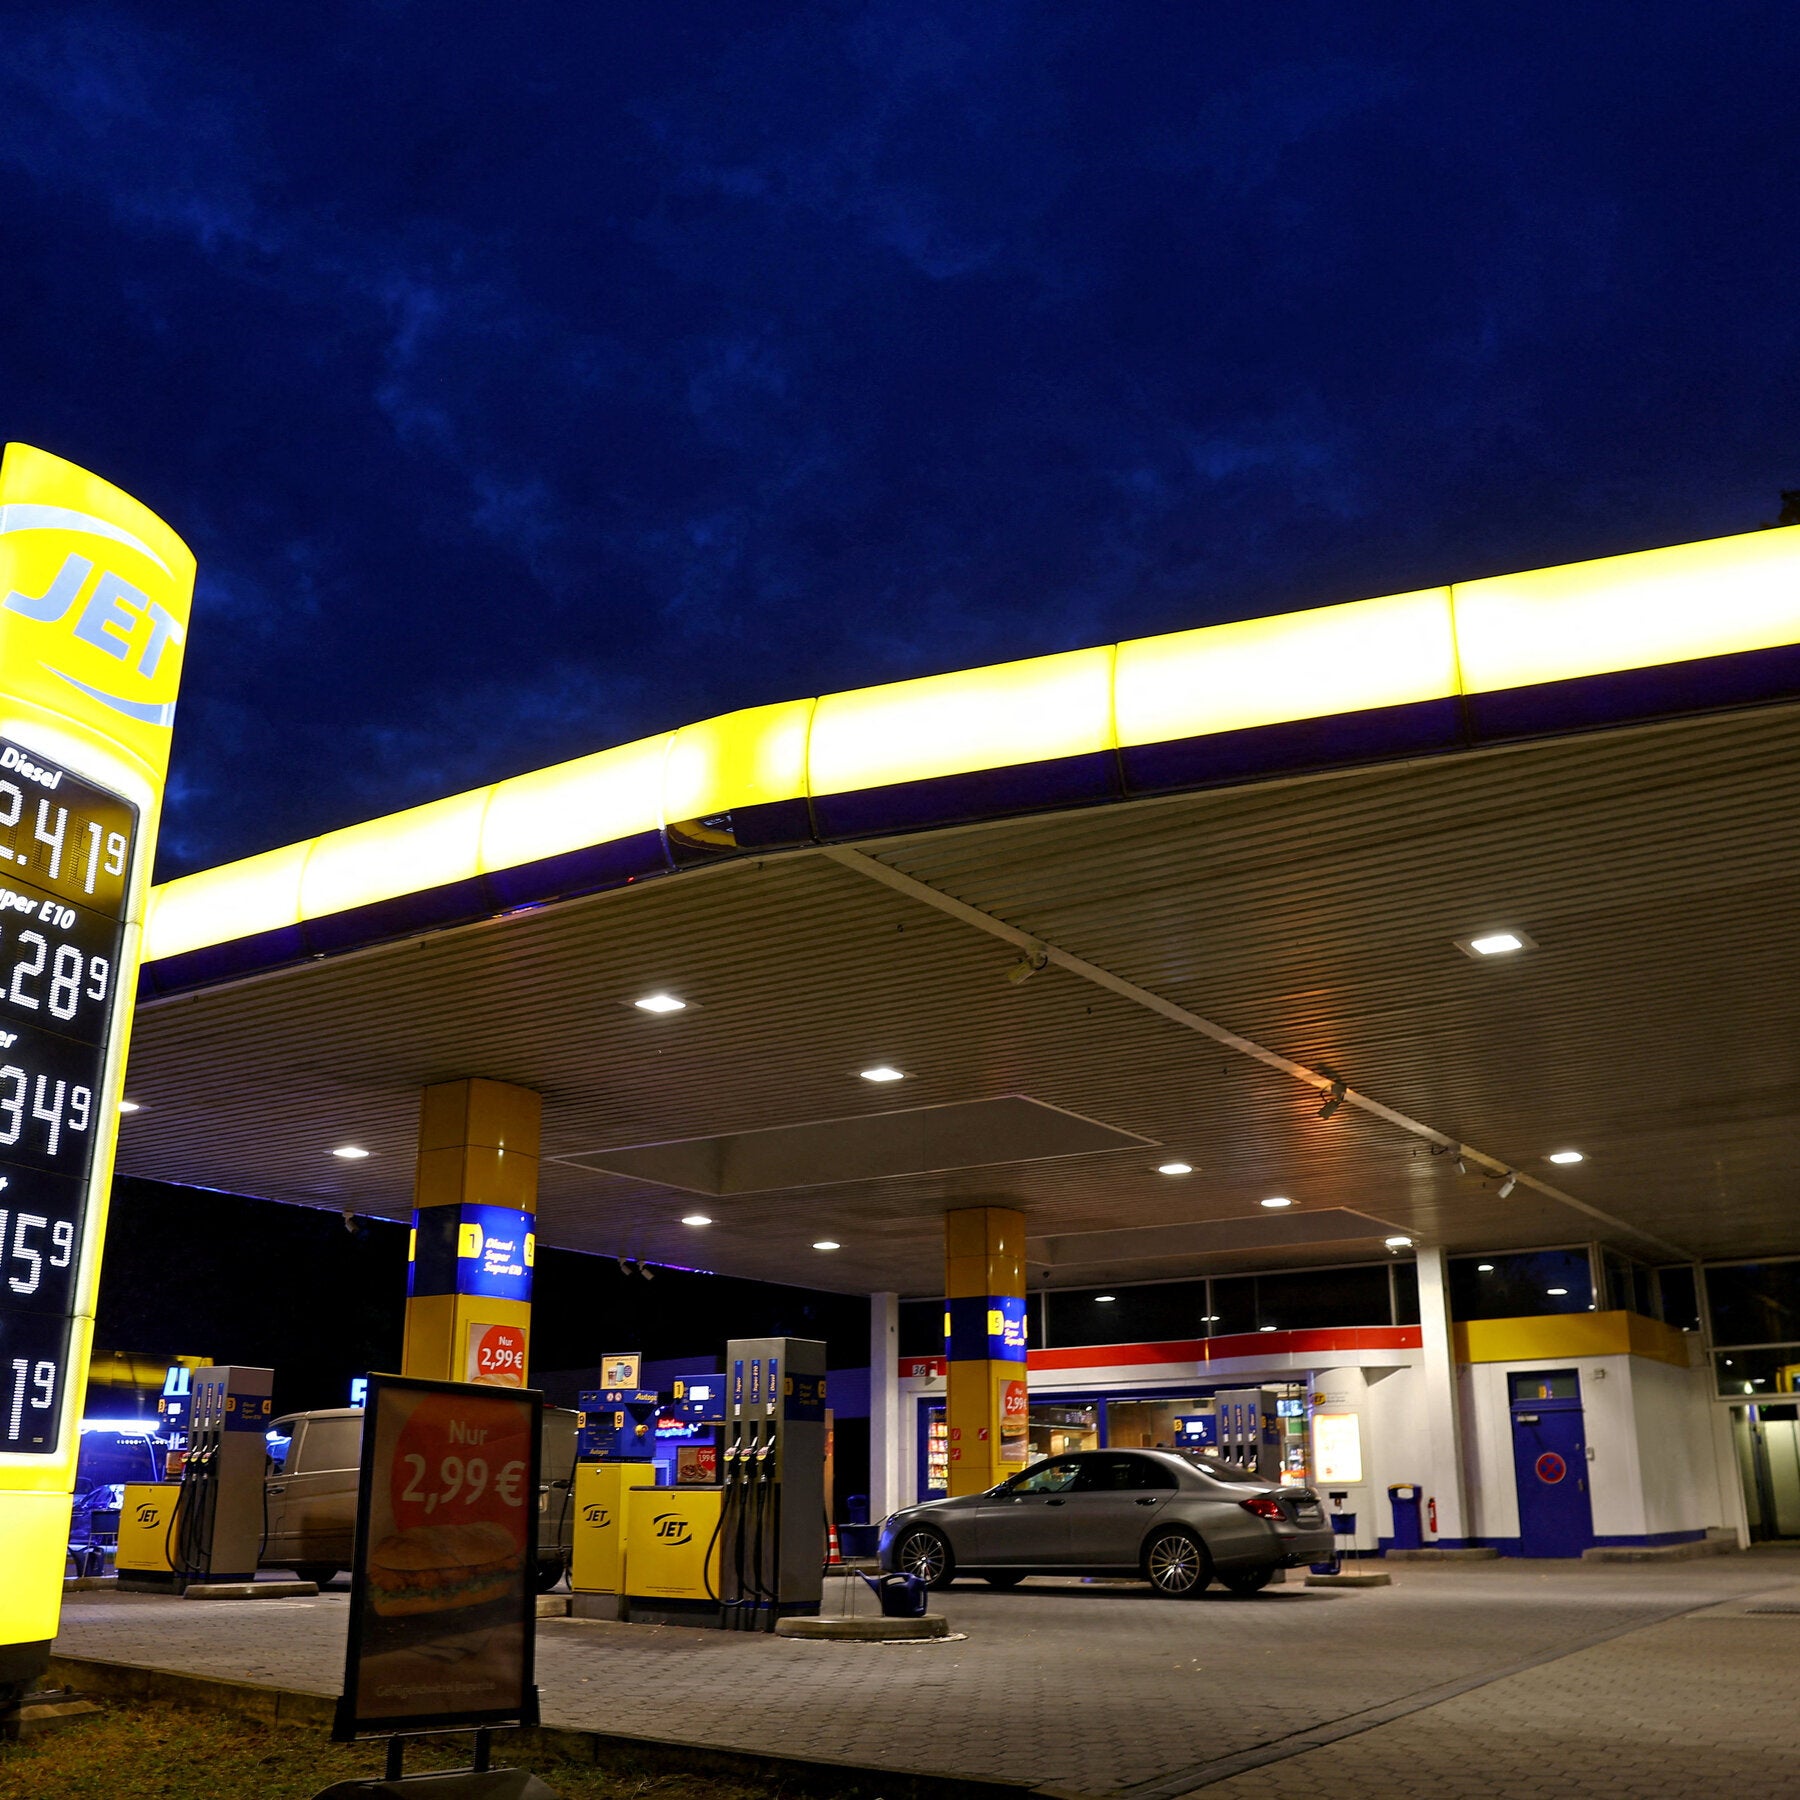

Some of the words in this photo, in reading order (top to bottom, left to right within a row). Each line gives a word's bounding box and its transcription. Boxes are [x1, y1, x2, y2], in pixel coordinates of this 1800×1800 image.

[2, 552, 184, 680] JET
[1, 746, 63, 790] Diesel
[38, 900, 76, 929] E10
[469, 1233, 476, 1249] 1
[498, 1336, 514, 1347] Nur
[914, 1365, 925, 1376] 36
[448, 1420, 488, 1446] Nur
[137, 1509, 159, 1522] JET
[585, 1510, 609, 1522] JET
[656, 1521, 689, 1537] JET
